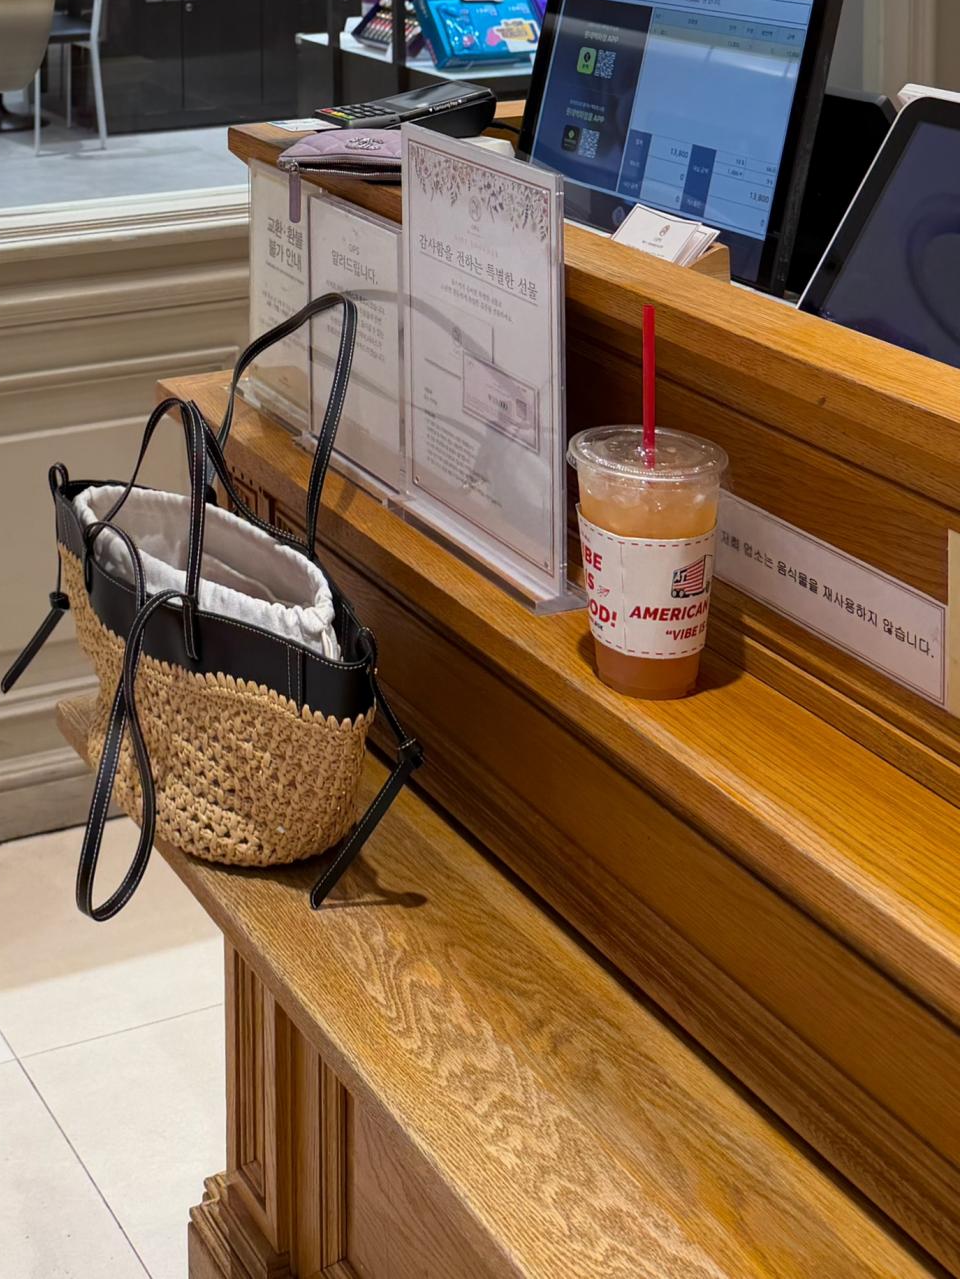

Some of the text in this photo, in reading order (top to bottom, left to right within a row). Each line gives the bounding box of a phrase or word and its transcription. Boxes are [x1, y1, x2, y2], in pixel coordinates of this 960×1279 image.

[269, 238, 302, 272] 불가 안내
[419, 234, 453, 262] 감사함을
[456, 250, 483, 276] 전하는
[486, 263, 514, 290] 특별한
[518, 278, 538, 301] 선물
[583, 543, 603, 572] BE
[589, 598, 617, 628] OD!
[629, 600, 708, 622] AMERICAN
[743, 542, 774, 570] 업소는
[776, 560, 818, 595] 음식물을
[822, 585, 878, 628] 재사용하지
[882, 618, 934, 658] 않습니다.
